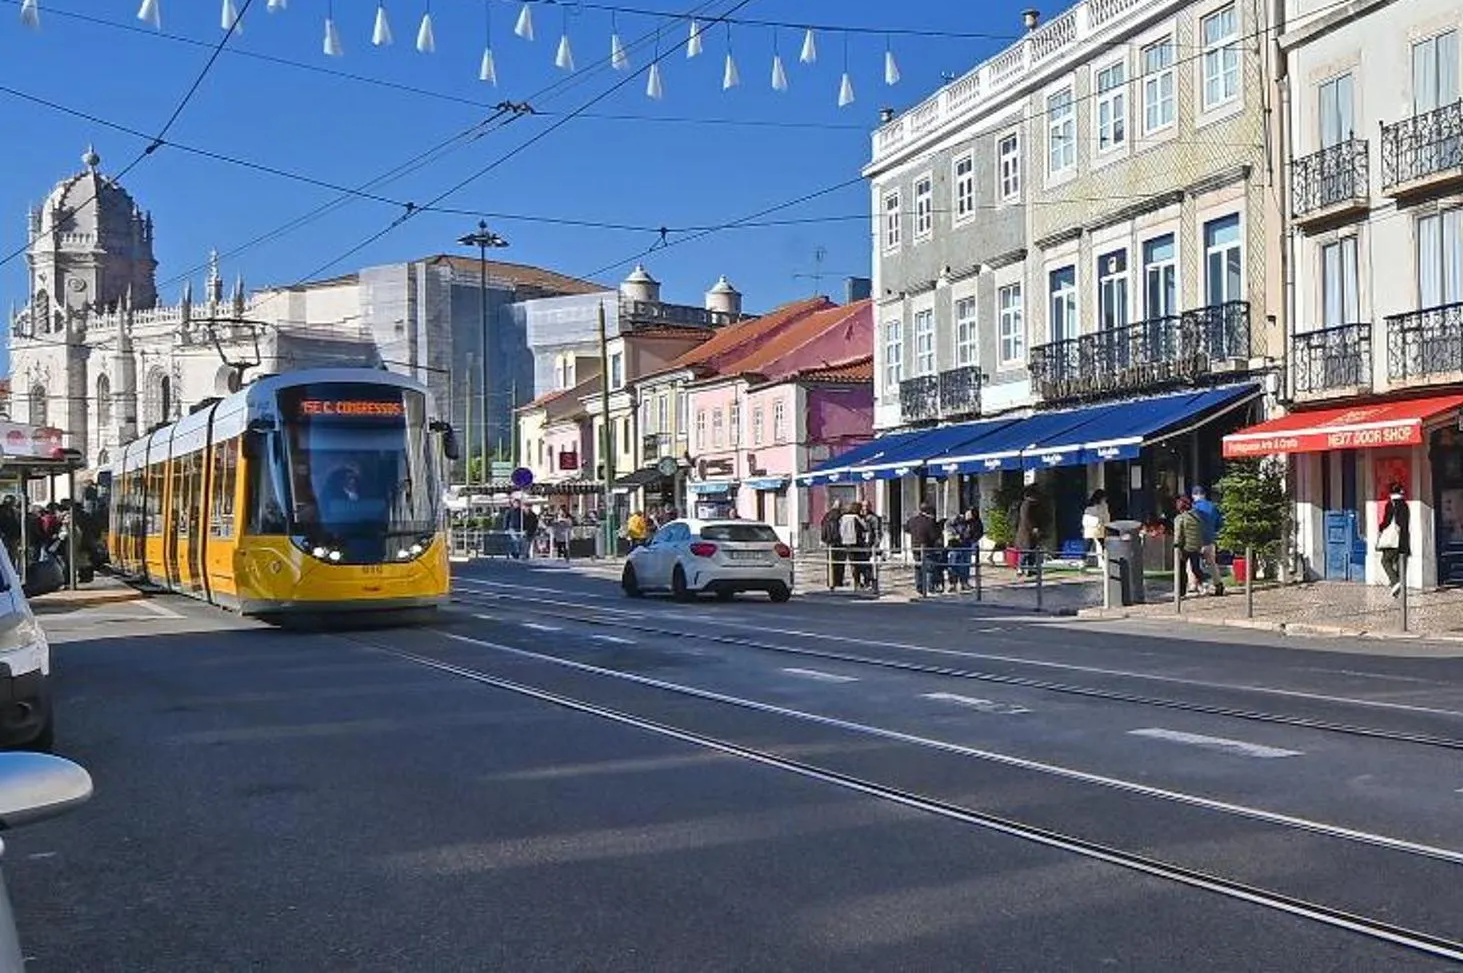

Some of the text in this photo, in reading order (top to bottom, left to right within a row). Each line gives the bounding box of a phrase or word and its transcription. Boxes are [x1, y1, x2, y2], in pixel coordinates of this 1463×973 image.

[1328, 426, 1412, 447] NEXT DOOR SHOP
